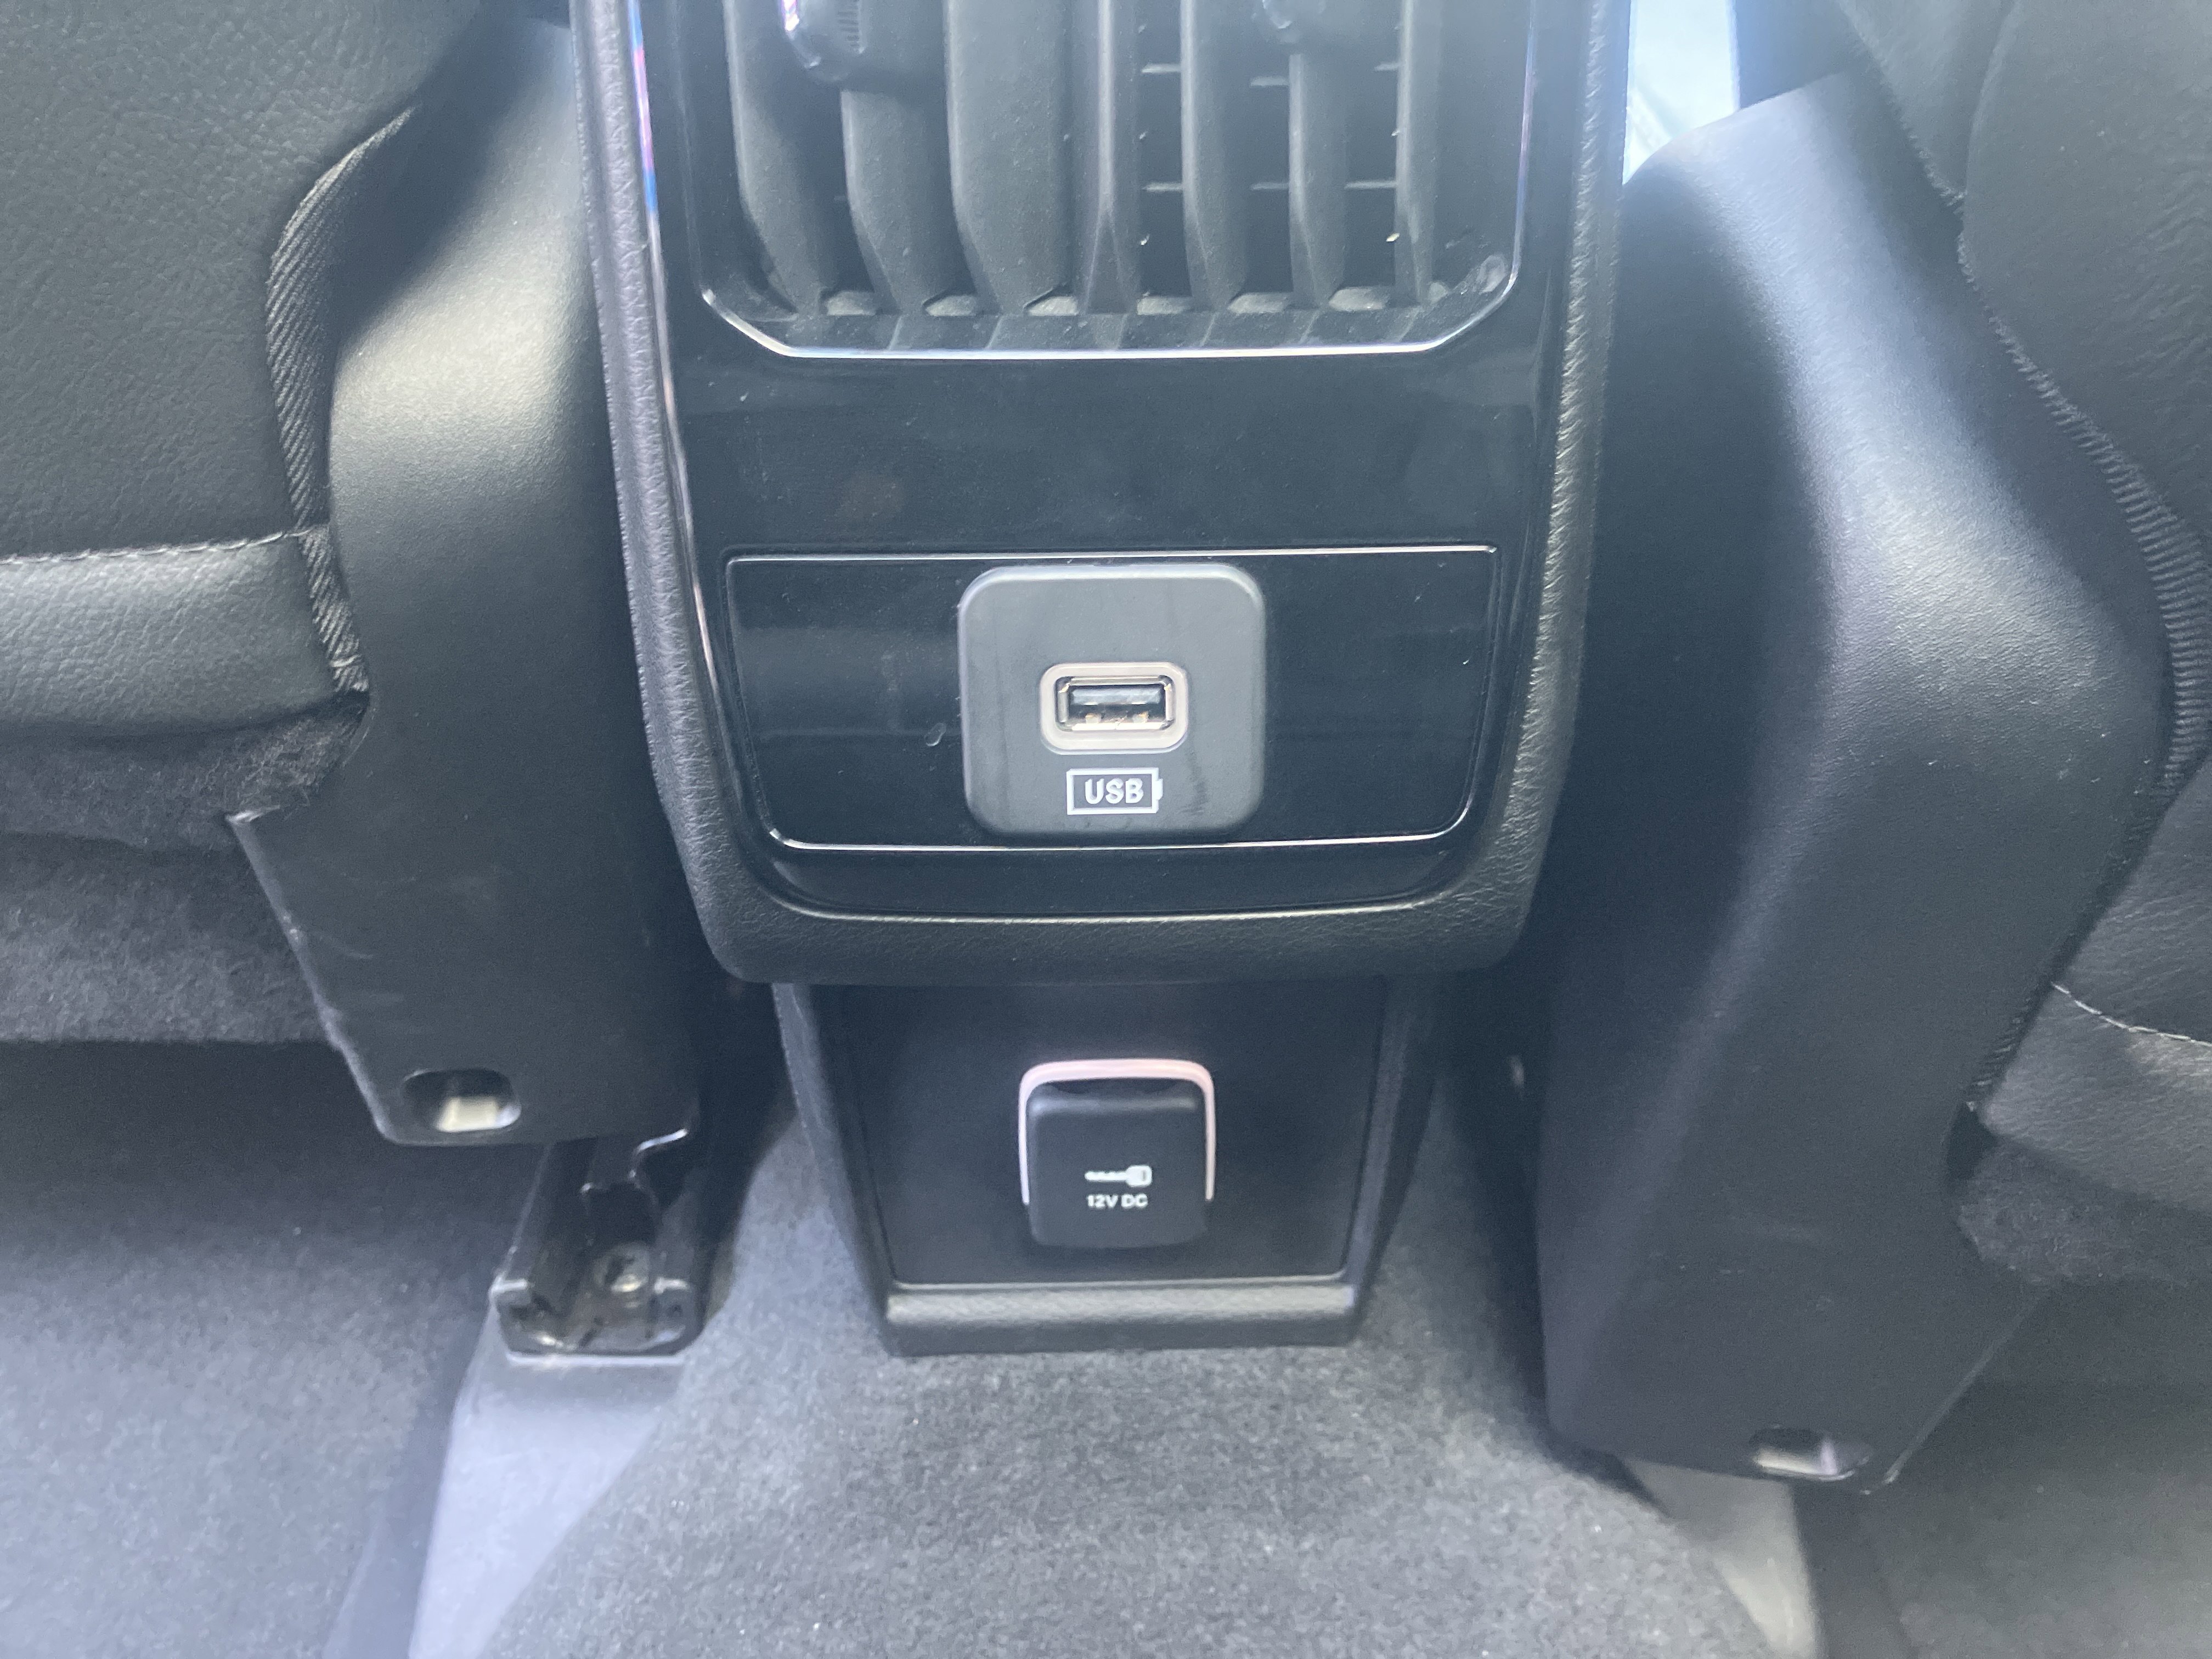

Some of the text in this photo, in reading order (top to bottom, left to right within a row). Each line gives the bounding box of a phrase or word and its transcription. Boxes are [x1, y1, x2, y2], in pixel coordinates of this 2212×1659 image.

[1085, 778, 1144, 804] USB
[1087, 1193, 1149, 1209] 12V DC
